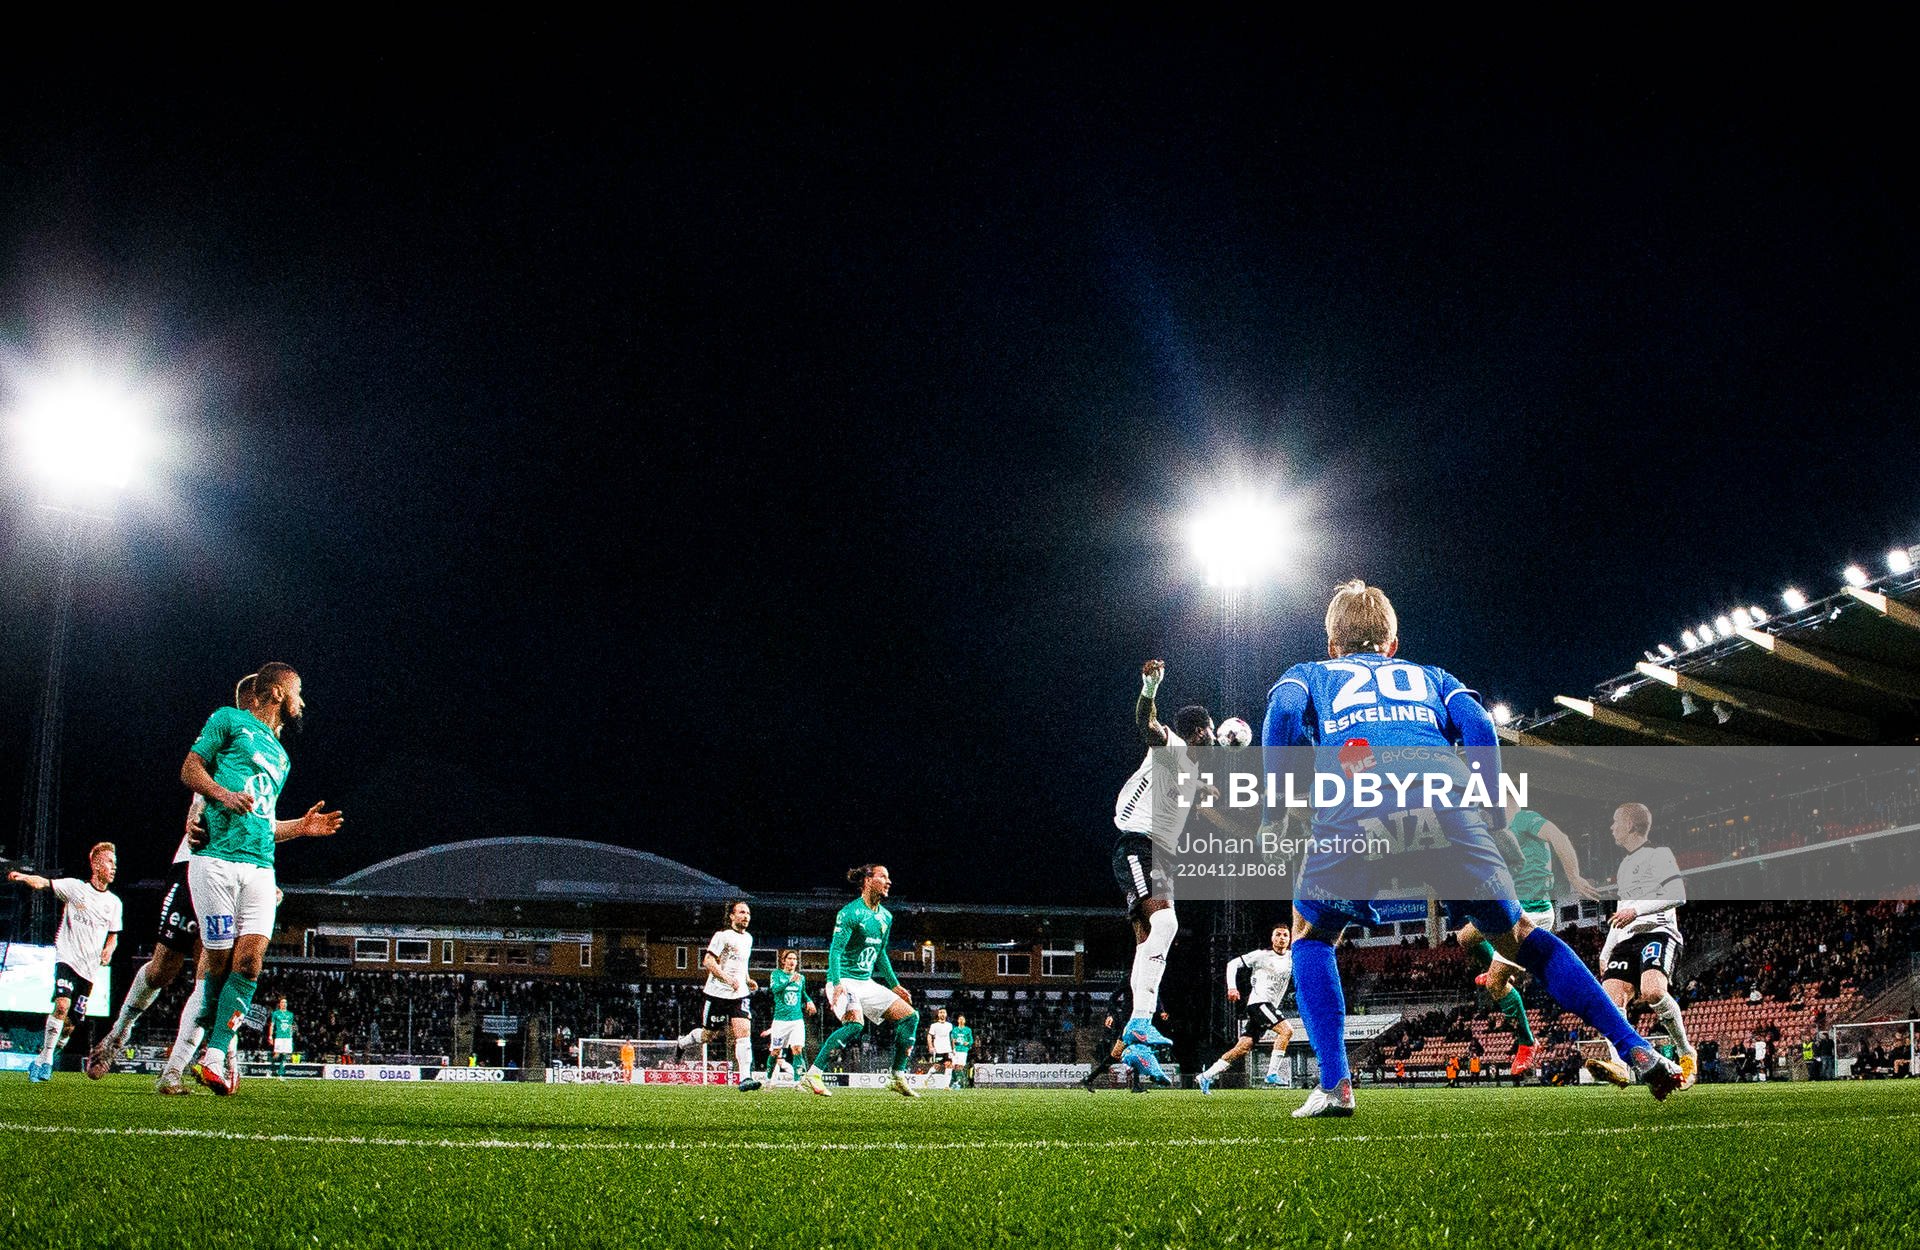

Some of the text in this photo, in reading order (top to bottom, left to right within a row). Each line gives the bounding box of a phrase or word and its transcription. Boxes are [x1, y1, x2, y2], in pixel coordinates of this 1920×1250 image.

[1325, 662, 1429, 713] 20
[1357, 806, 1453, 862] NA
[205, 914, 234, 936] NP
[434, 1069, 504, 1081] ARBESKO
